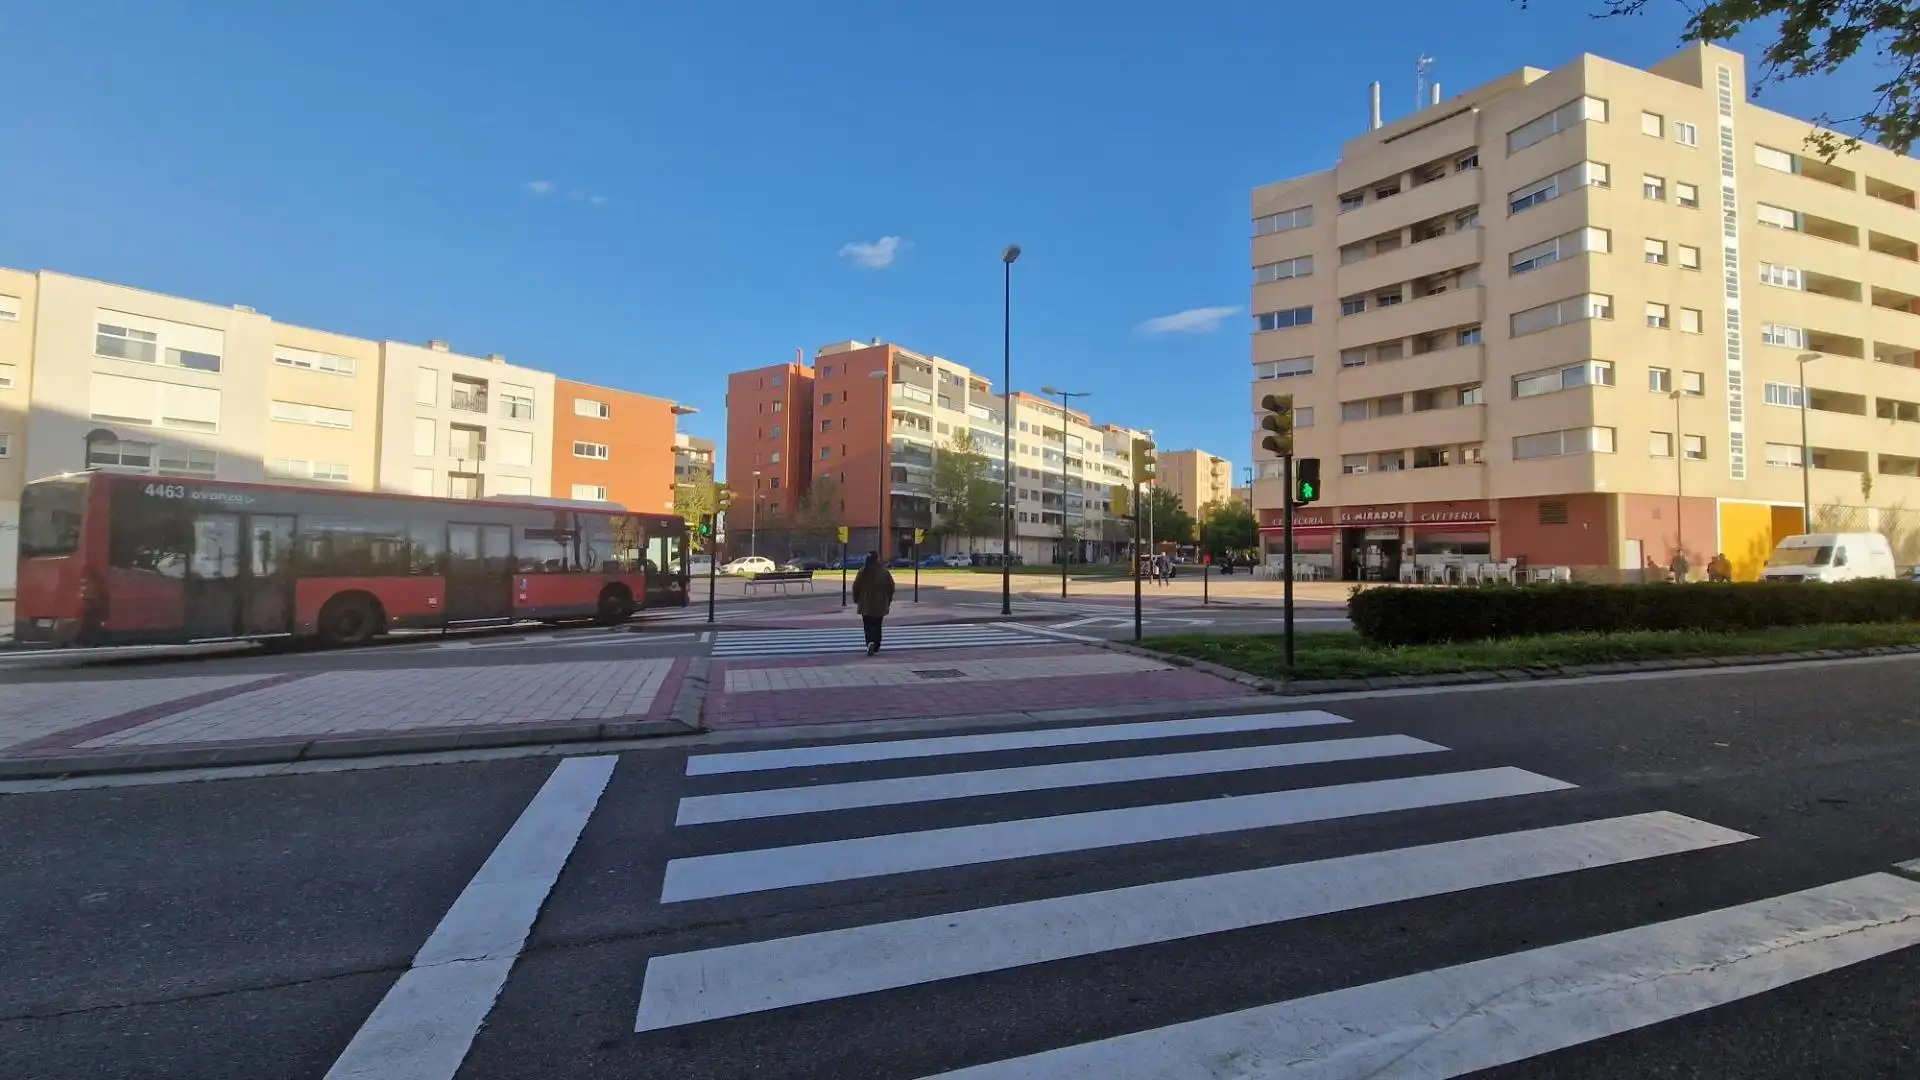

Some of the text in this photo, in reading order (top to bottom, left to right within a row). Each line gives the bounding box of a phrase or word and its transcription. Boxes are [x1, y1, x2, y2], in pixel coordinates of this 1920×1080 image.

[145, 483, 185, 498] 4463
[1342, 511, 1405, 521] EL MIRADOR
[1420, 511, 1480, 521] CAFETERIA
[1273, 517, 1324, 526] CEECERIA
